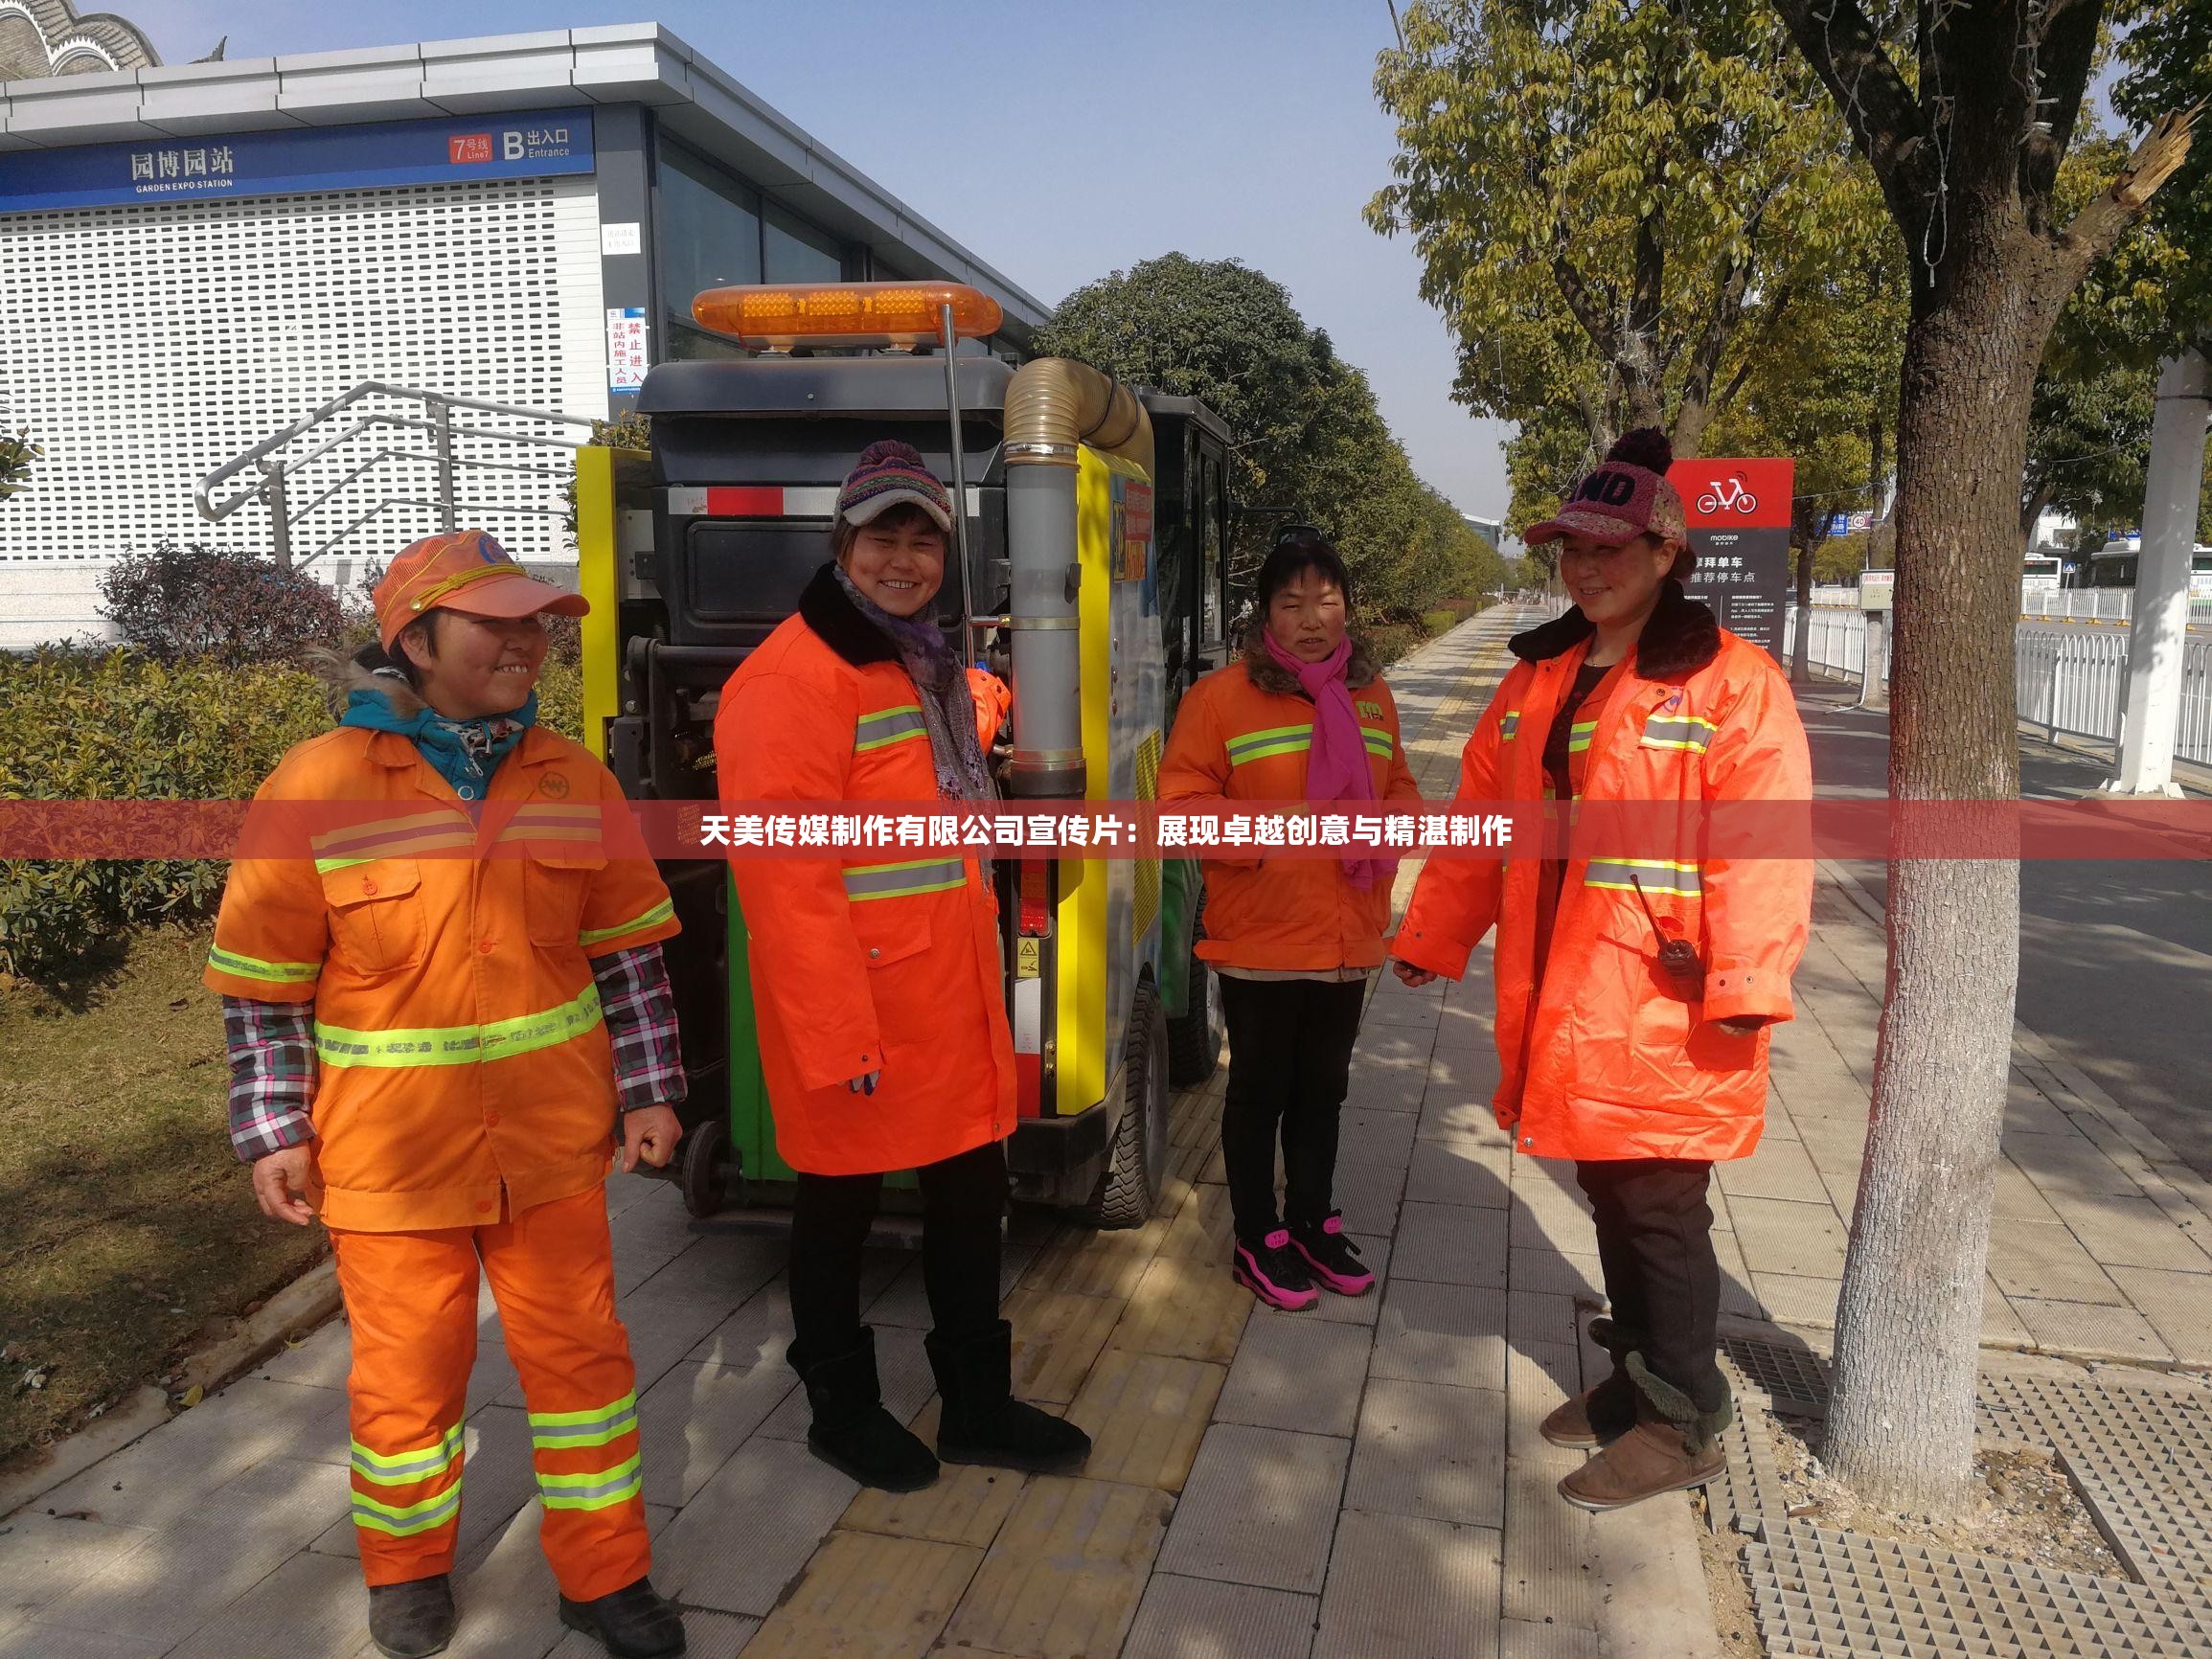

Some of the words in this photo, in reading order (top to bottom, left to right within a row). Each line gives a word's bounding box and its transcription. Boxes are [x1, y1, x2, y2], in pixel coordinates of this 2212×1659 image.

[467, 138, 489, 151] 号线
[503, 131, 525, 160] B
[528, 129, 568, 145] 出入口
[453, 139, 466, 160] 7
[528, 148, 570, 159] Entrance
[131, 146, 234, 180] 园博园站
[136, 183, 171, 193] GARDEN
[172, 181, 196, 191] EXPO
[197, 179, 233, 190] STATION
[612, 323, 627, 384] 非站内施工人员
[628, 323, 644, 383] 禁止进入
[1690, 571, 1756, 583] 推荐停车点
